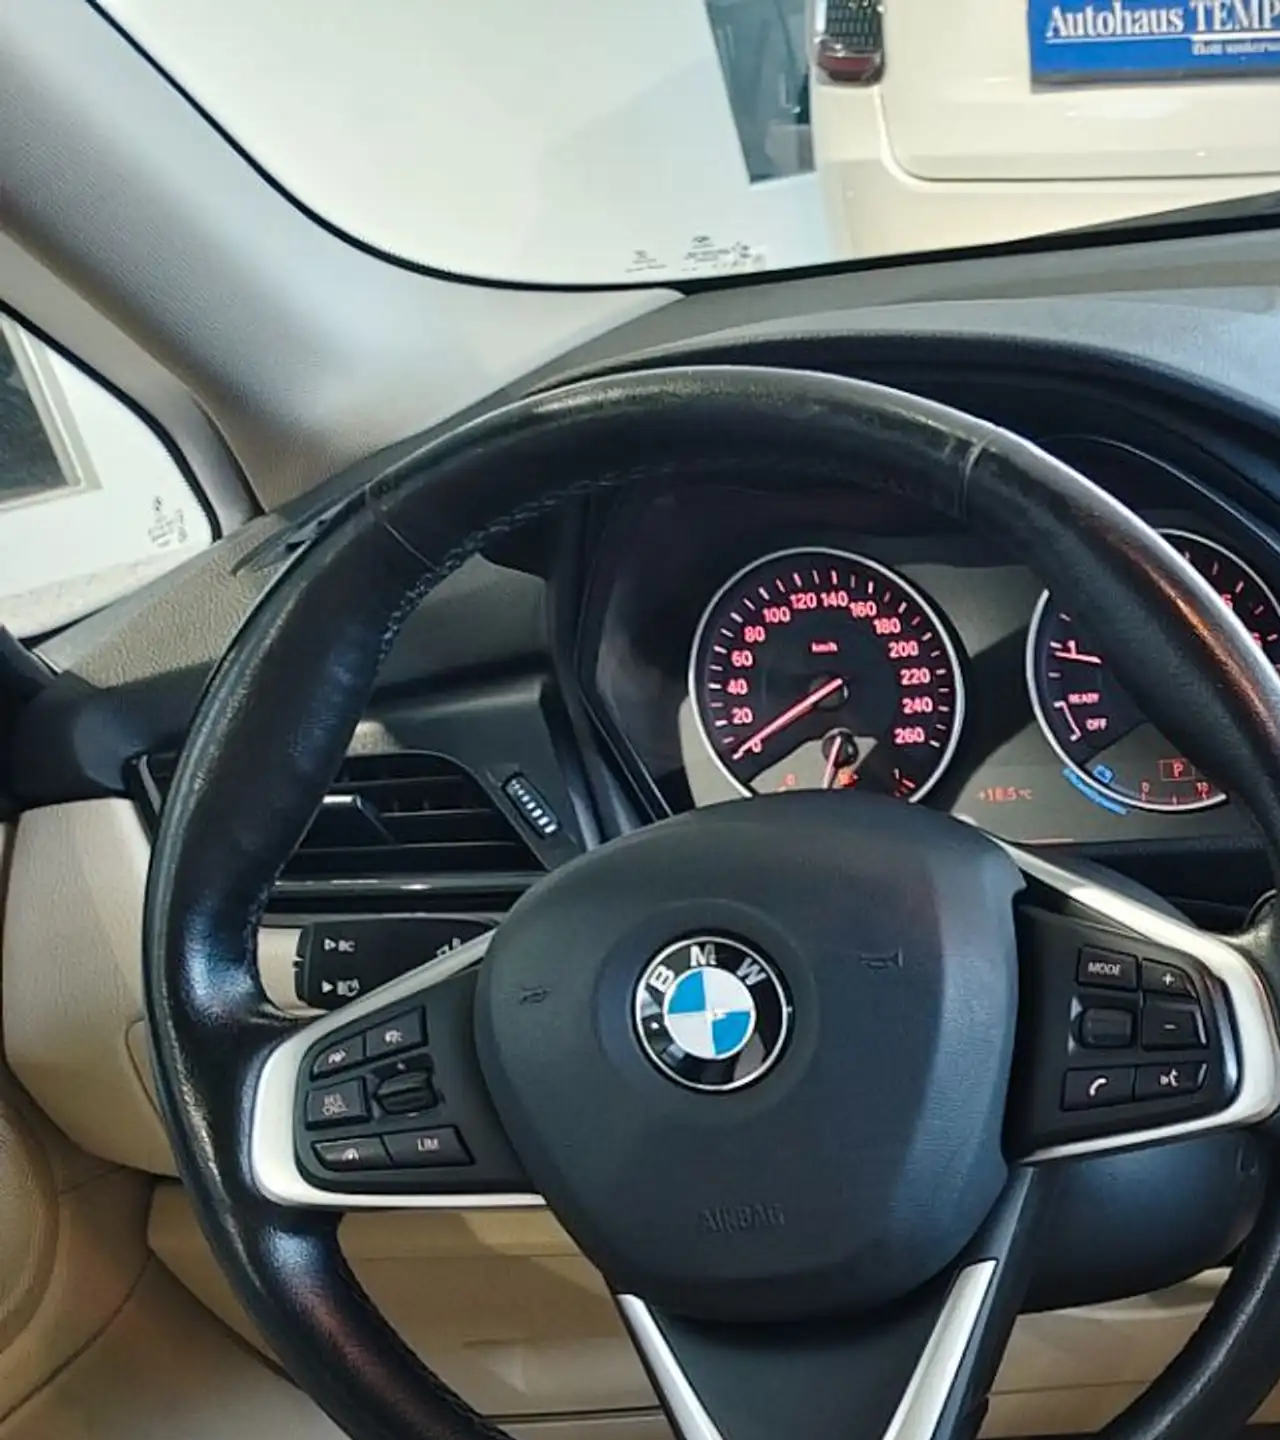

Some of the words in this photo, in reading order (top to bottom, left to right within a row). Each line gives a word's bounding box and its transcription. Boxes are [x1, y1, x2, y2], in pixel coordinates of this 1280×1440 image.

[1046, 6, 1185, 38] Autohaus
[789, 592, 818, 609] 120
[820, 591, 849, 607] 140
[762, 606, 791, 623] 100
[849, 601, 877, 618] 160
[743, 626, 766, 642] 80
[872, 617, 901, 635] 180
[888, 641, 919, 658] 200
[731, 651, 753, 667] 60
[900, 668, 930, 685] 220
[726, 678, 748, 695] 40
[902, 697, 933, 714] 240
[732, 707, 753, 724] 20
[894, 727, 925, 744] 260
[648, 943, 768, 993] BMW
[1088, 961, 1122, 976] MODE
[416, 1137, 440, 1151] LIM
